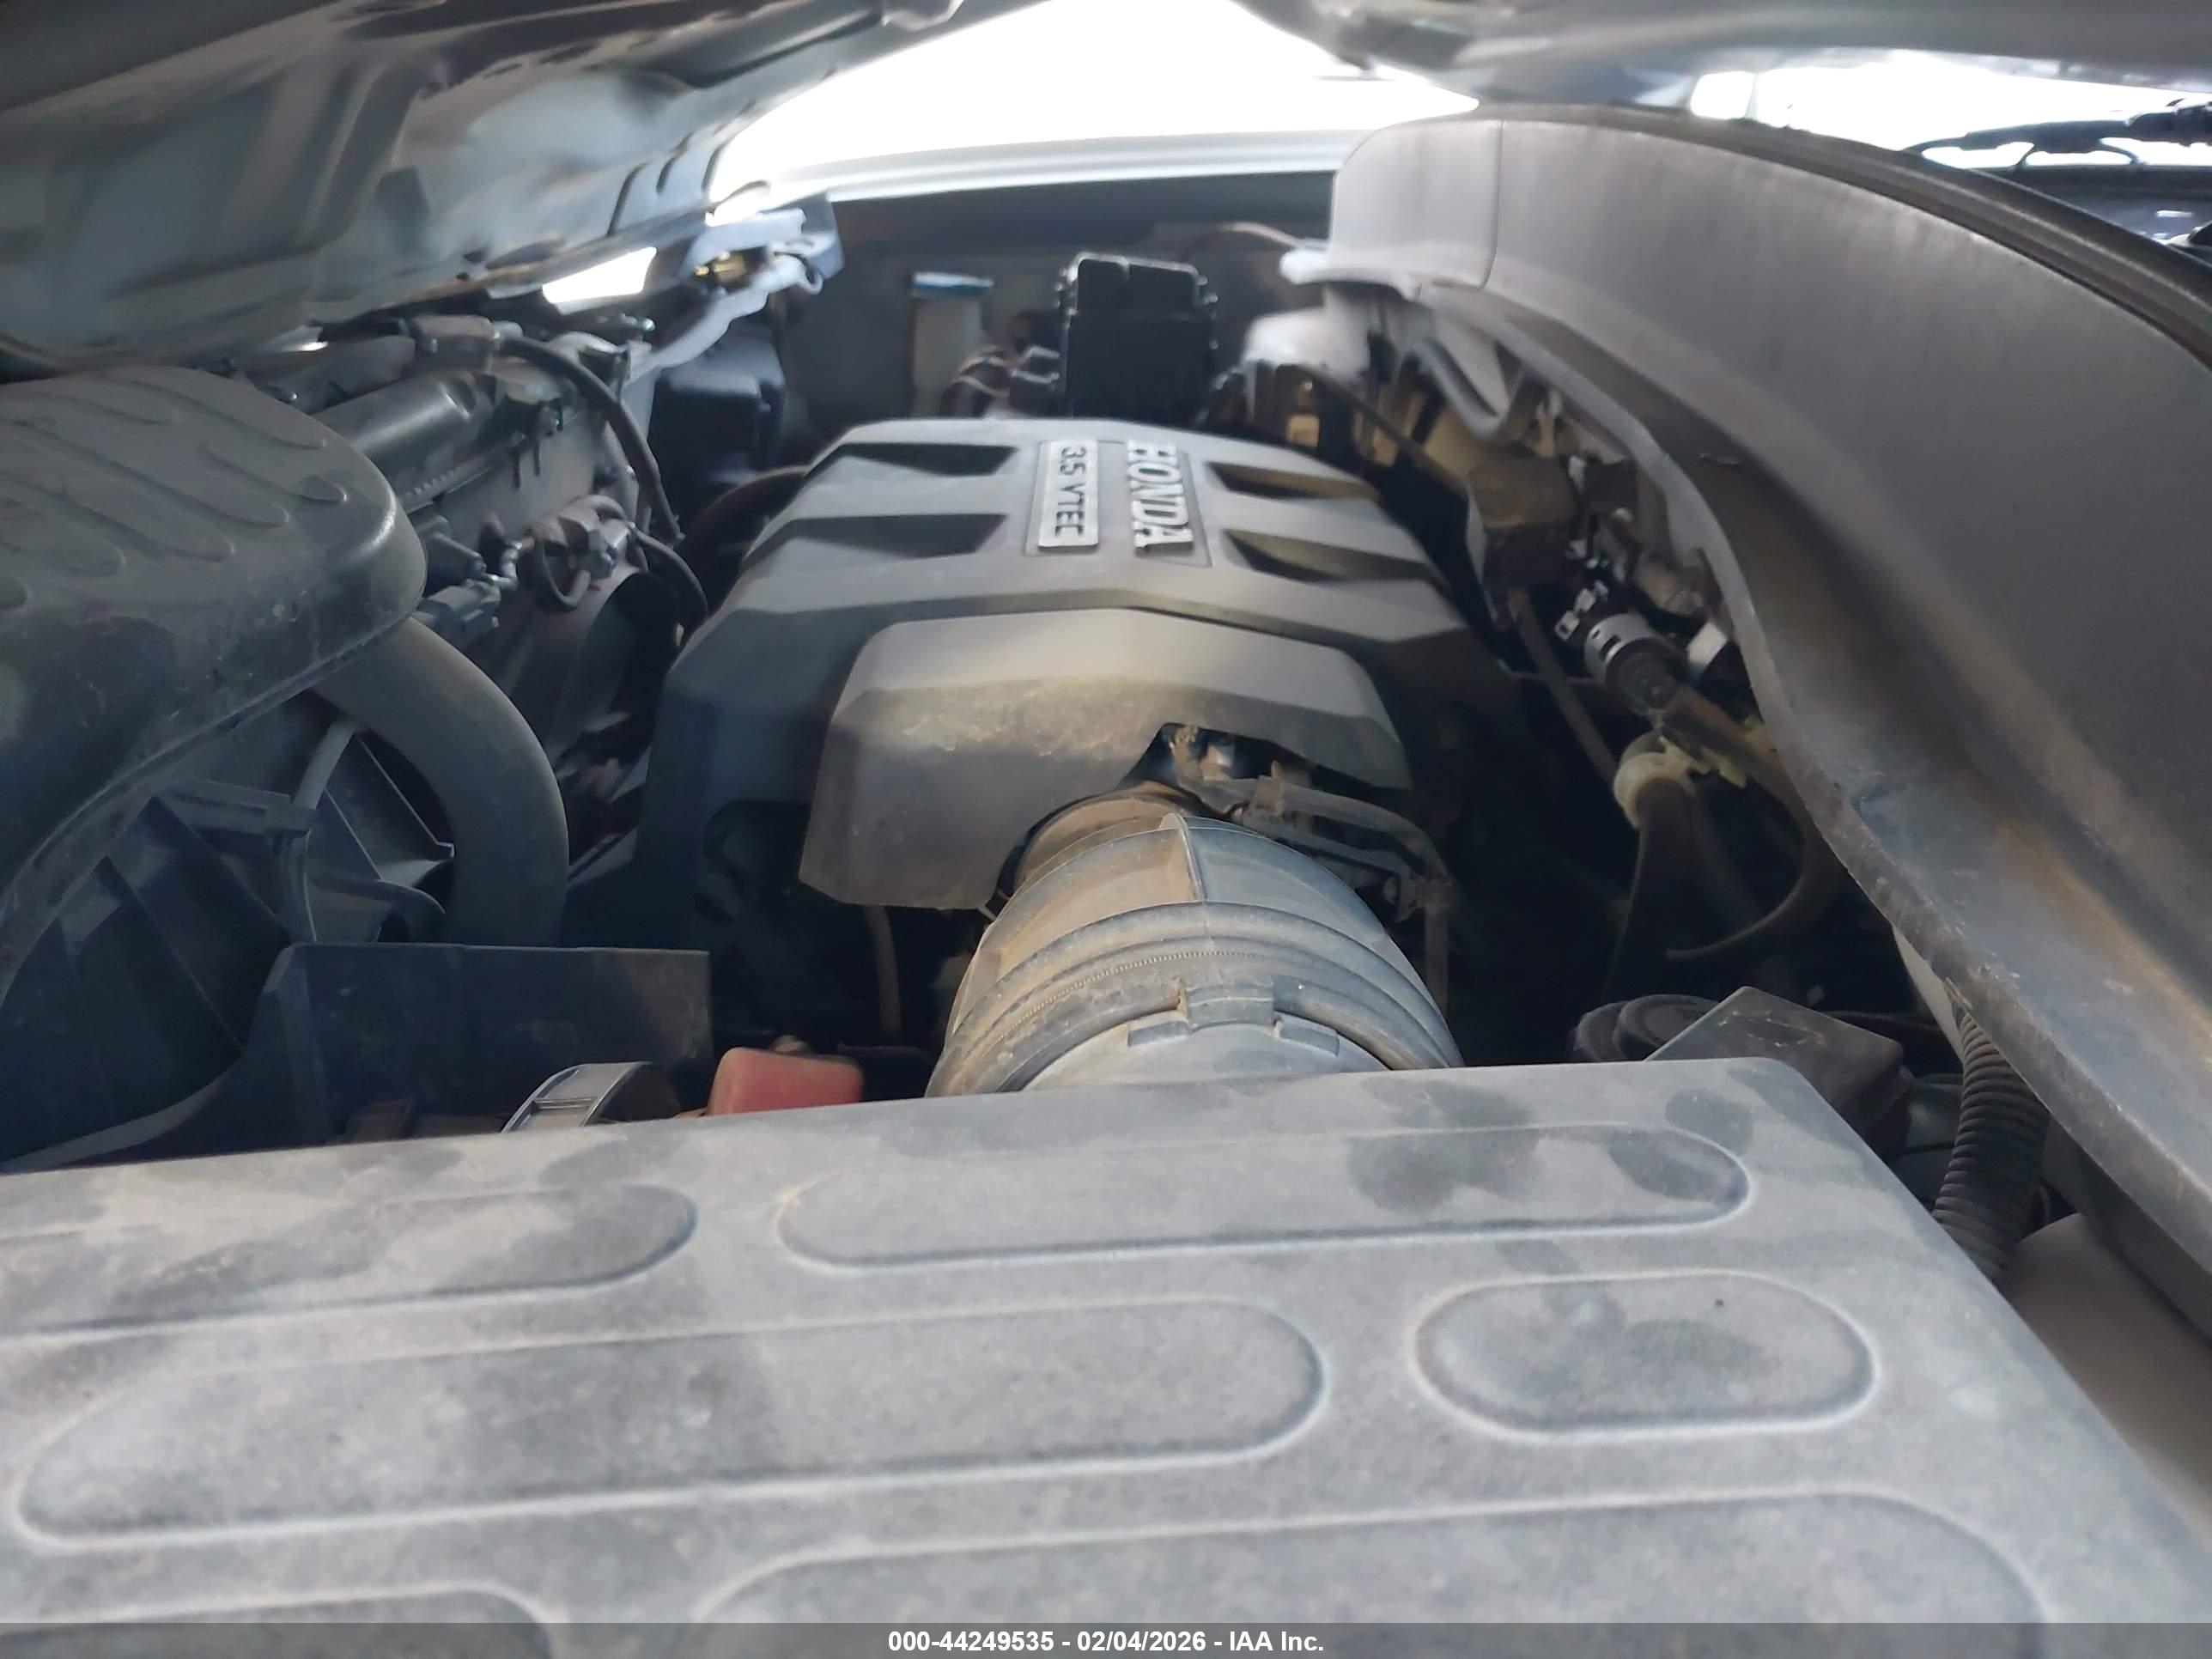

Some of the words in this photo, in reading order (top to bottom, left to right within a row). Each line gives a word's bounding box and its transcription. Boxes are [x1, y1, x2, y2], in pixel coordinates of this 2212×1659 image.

[1060, 446, 1087, 476] 3.5
[1054, 482, 1086, 537] VTEC
[1127, 441, 1194, 547] HONDA
